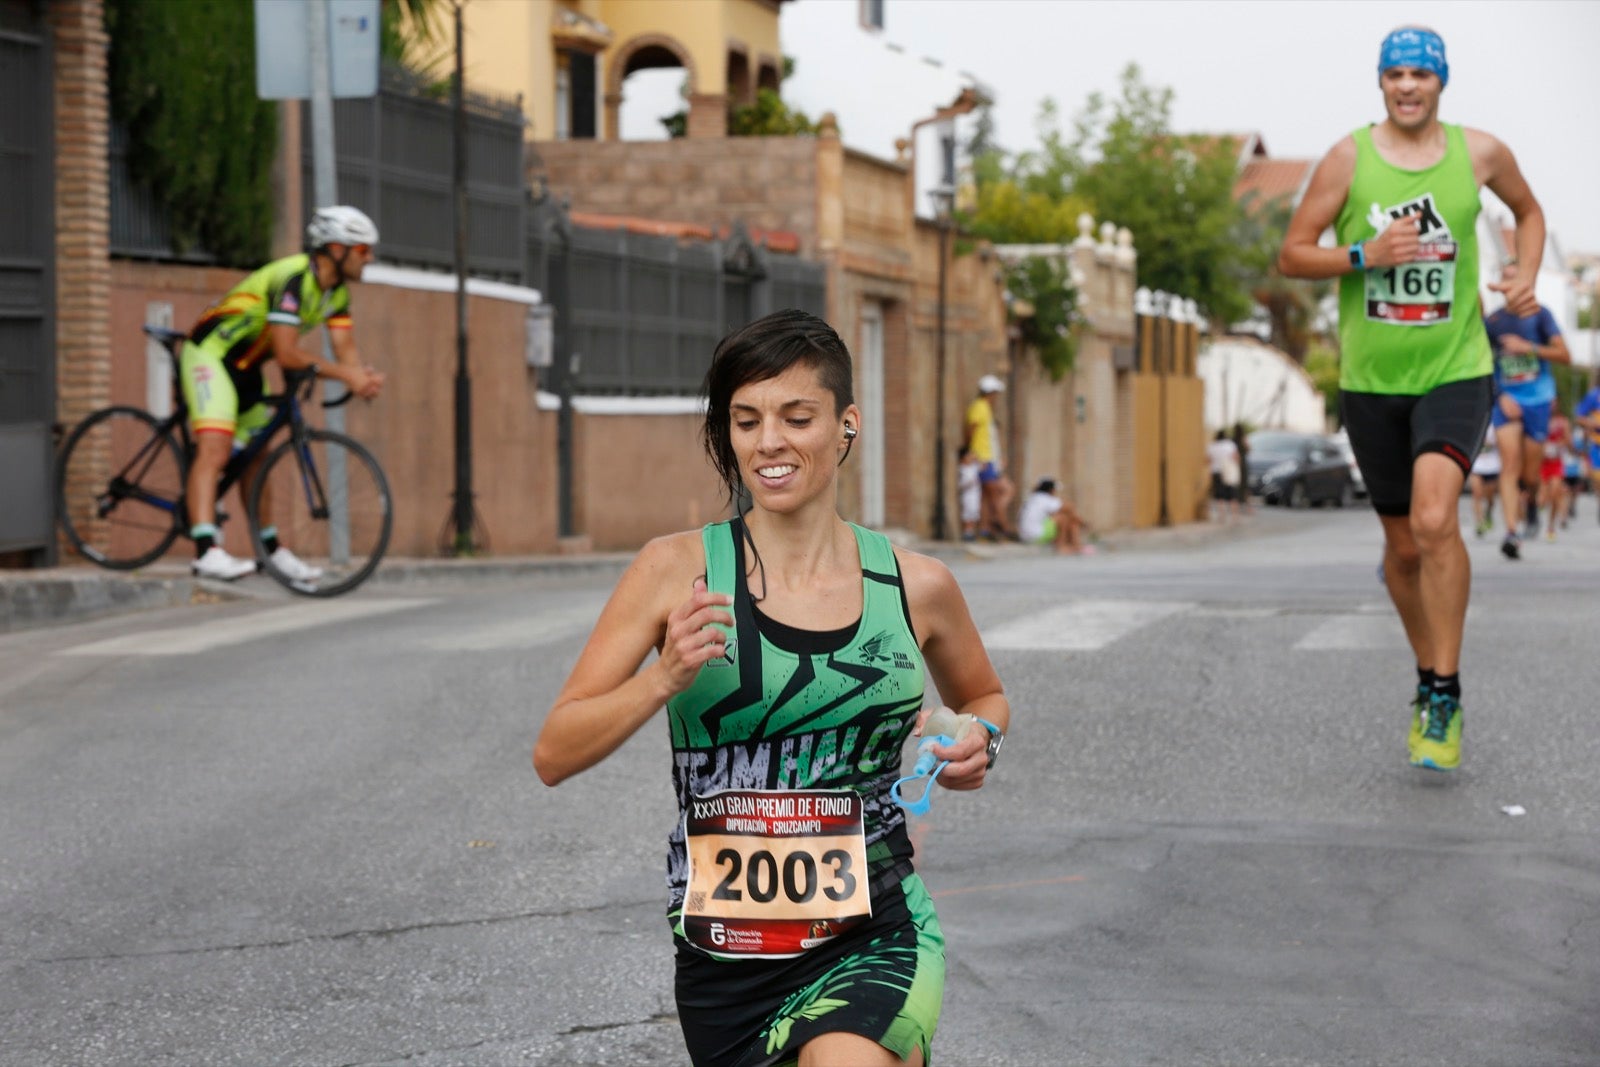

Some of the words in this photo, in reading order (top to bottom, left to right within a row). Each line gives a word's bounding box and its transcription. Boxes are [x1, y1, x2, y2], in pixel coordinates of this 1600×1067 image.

[1382, 267, 1443, 296] 166
[693, 799, 725, 819] XXXII
[726, 796, 754, 815] GRAN
[756, 797, 794, 817] PREMIO
[798, 798, 812, 816] DE
[815, 797, 851, 816] FONDO
[726, 818, 767, 833] DIPUTACIÓN
[773, 820, 821, 834] CRUZCAMPO
[711, 848, 857, 904] 2003
